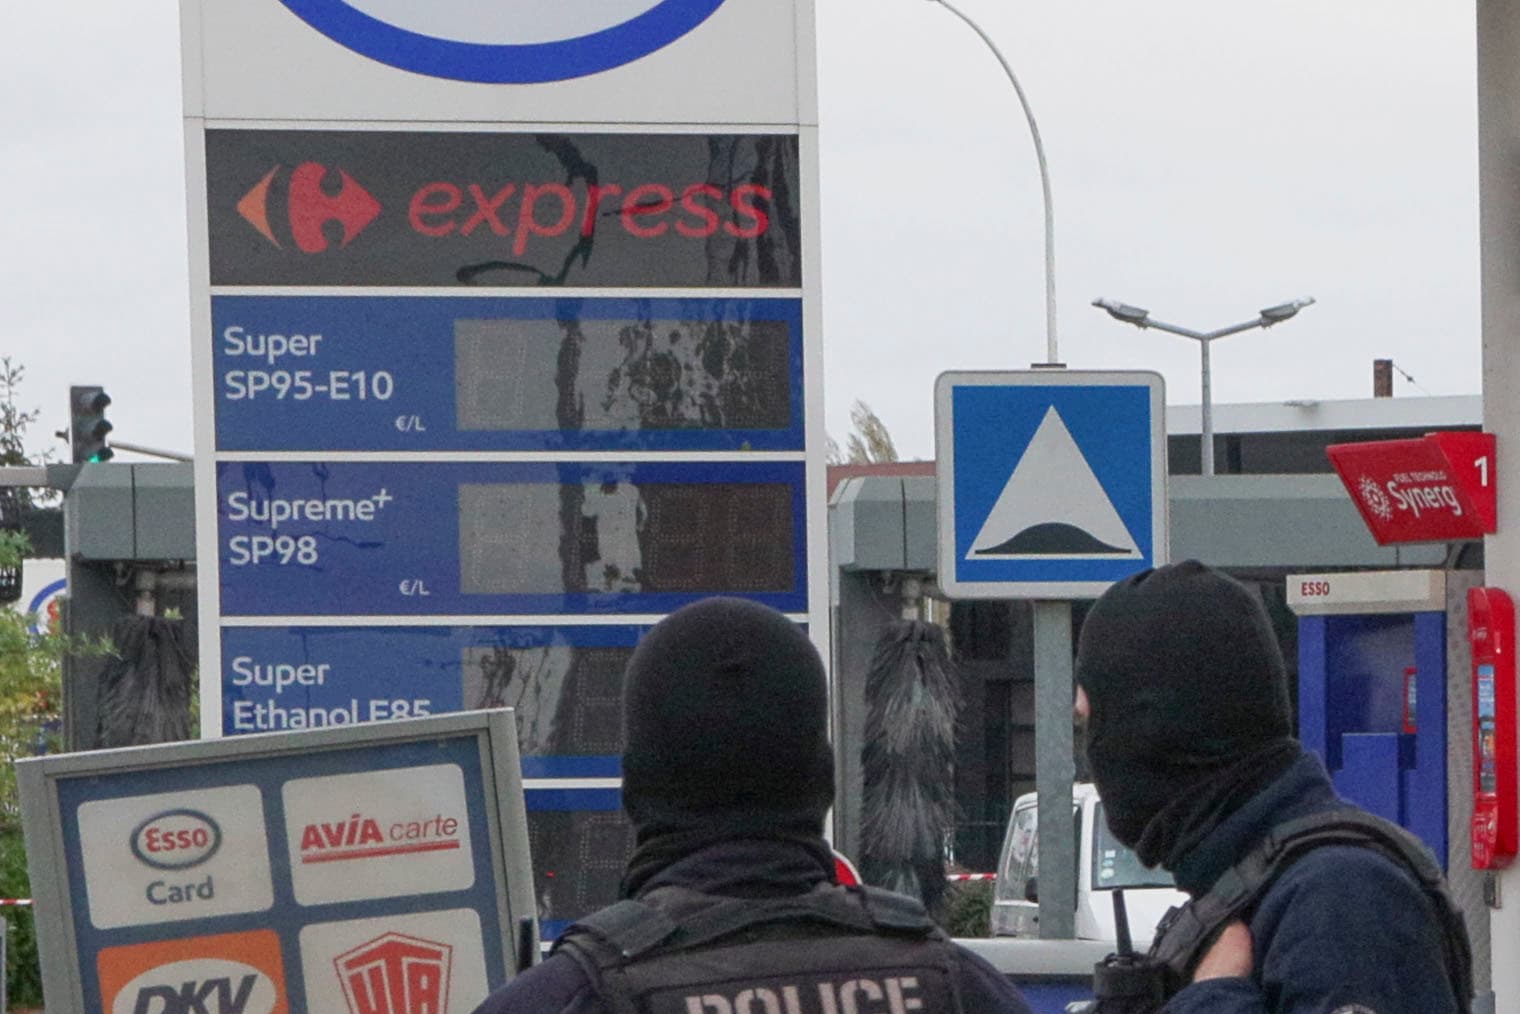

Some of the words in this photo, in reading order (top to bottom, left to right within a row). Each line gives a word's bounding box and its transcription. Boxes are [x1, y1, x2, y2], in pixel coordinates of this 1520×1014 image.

[407, 181, 773, 256] express
[224, 326, 322, 364] Super
[225, 370, 394, 400] SP95-E10
[395, 415, 426, 431] €/L
[1475, 456, 1488, 487] 1
[1387, 481, 1462, 518] Synerg
[229, 536, 318, 565] SP98
[399, 580, 429, 595] €/L
[1301, 582, 1330, 596] ESSO
[232, 656, 330, 694] Super
[233, 699, 359, 730] Ethanol
[389, 814, 459, 842] carte
[146, 876, 215, 906] Card
